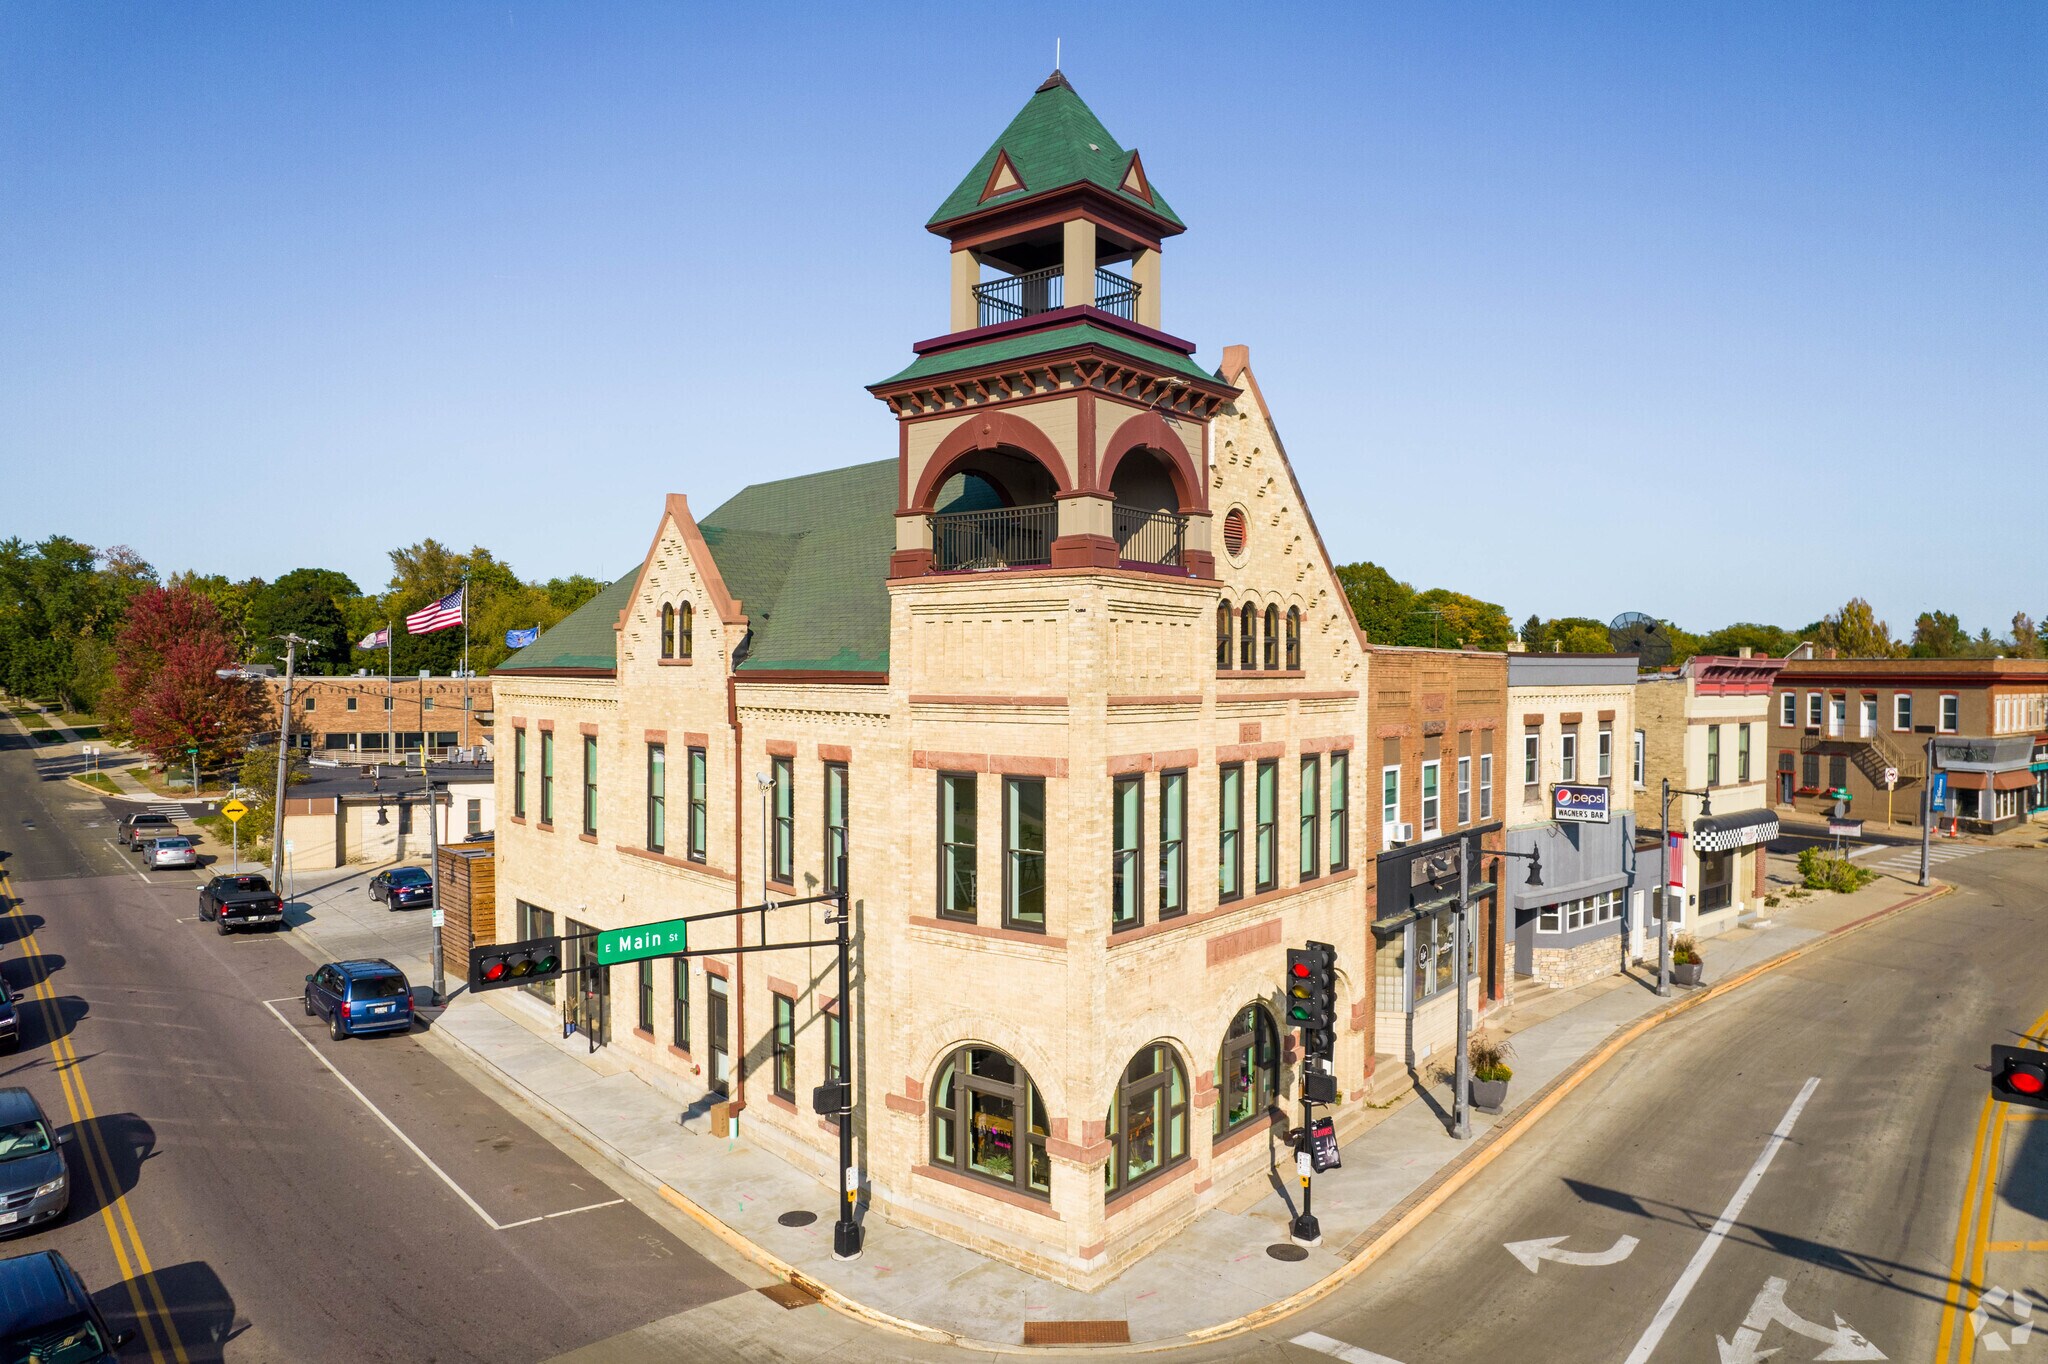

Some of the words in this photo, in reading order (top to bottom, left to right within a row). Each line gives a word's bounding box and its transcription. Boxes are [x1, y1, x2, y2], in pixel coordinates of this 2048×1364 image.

[1572, 793, 1604, 805] pepsi
[1591, 811, 1604, 819] BAR
[605, 944, 611, 953] E
[619, 932, 661, 952] Main
[668, 933, 679, 942] St
